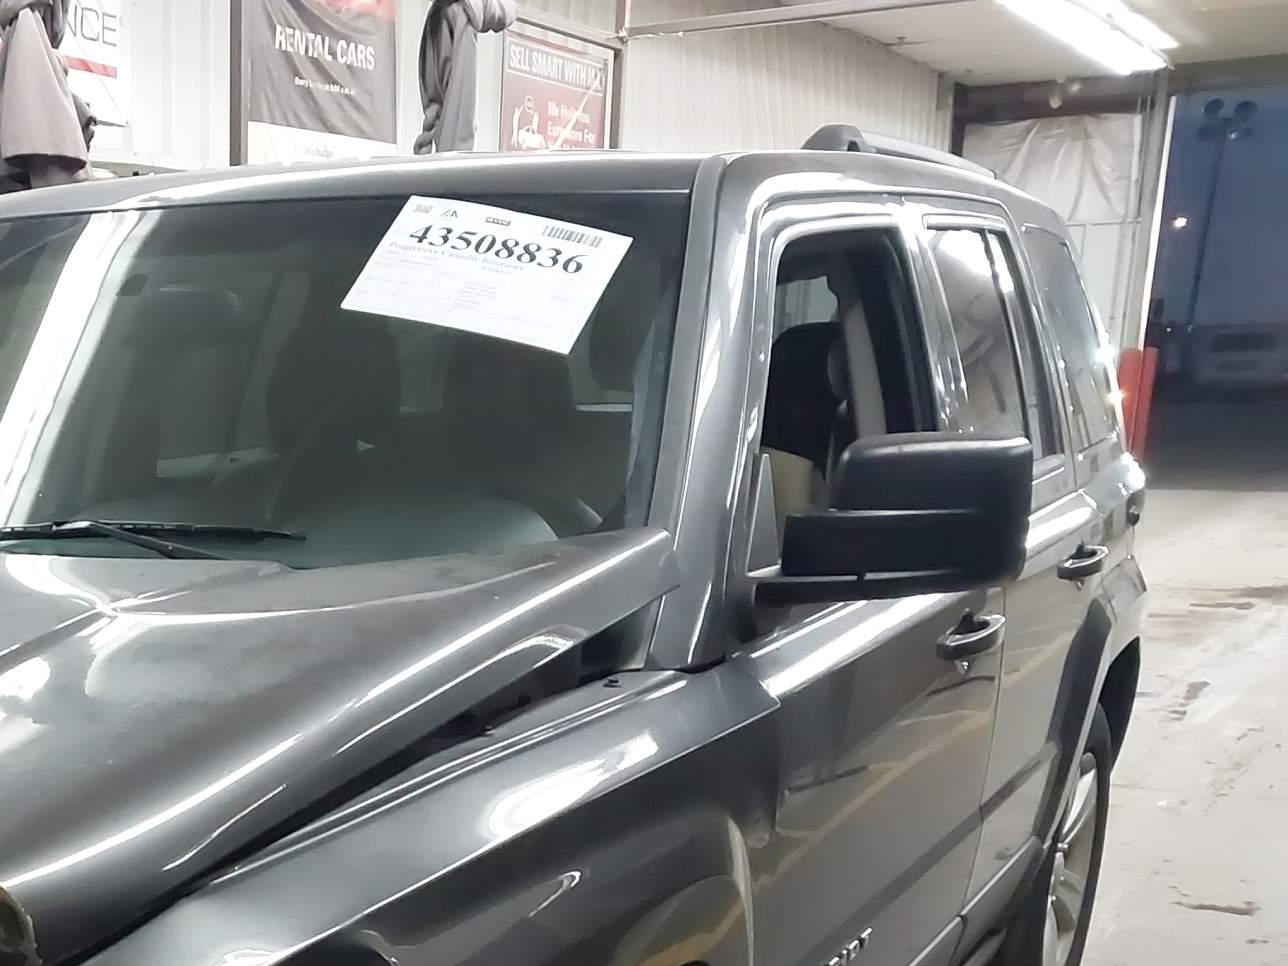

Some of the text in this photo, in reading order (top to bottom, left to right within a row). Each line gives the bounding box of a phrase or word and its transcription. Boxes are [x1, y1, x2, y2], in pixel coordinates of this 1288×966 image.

[275, 23, 376, 70] RENTAL CARS
[509, 44, 530, 71] SELL
[532, 52, 563, 81] SMART
[409, 224, 589, 274] 43508836
